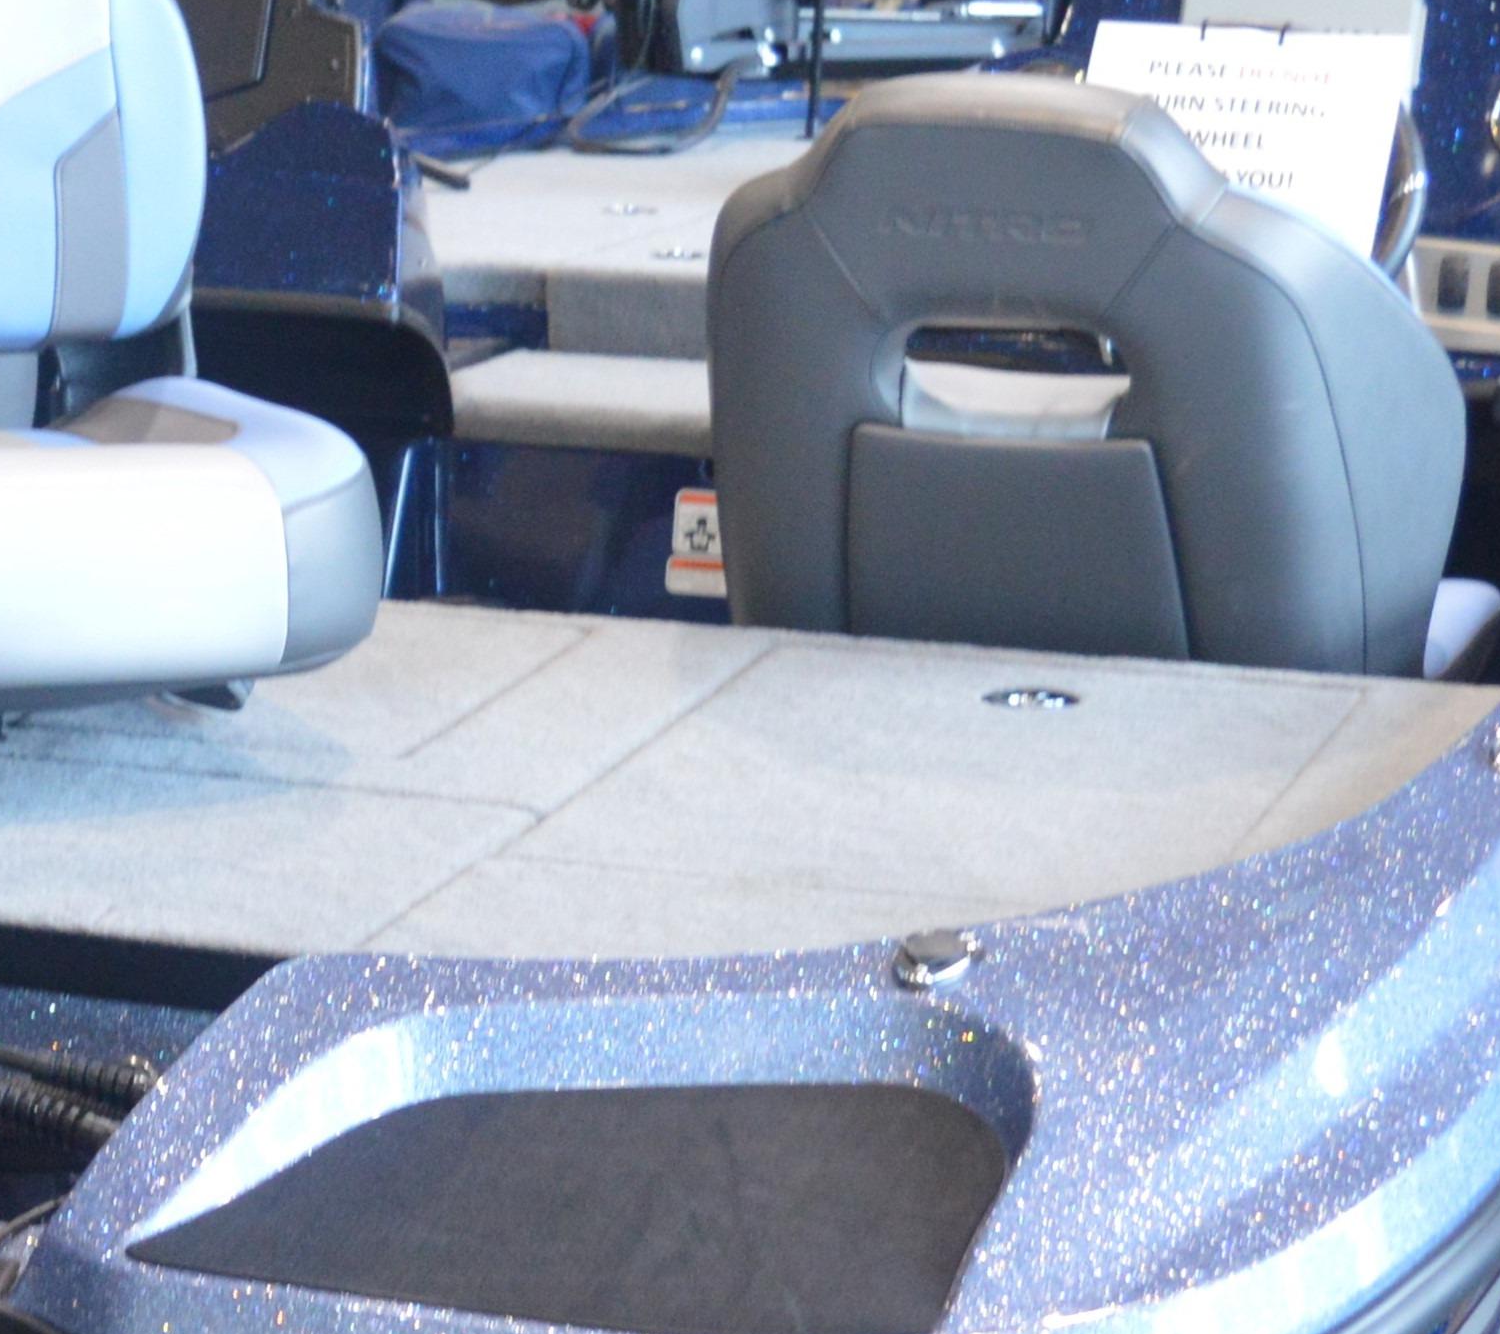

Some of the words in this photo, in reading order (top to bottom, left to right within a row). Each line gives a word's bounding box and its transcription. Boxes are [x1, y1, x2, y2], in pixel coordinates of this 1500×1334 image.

[1149, 59, 1227, 78] PLEASE
[1150, 93, 1206, 112] URN
[1214, 96, 1326, 118] STEERING
[1186, 129, 1266, 150] WHEEL
[1235, 169, 1294, 189] YOU!
